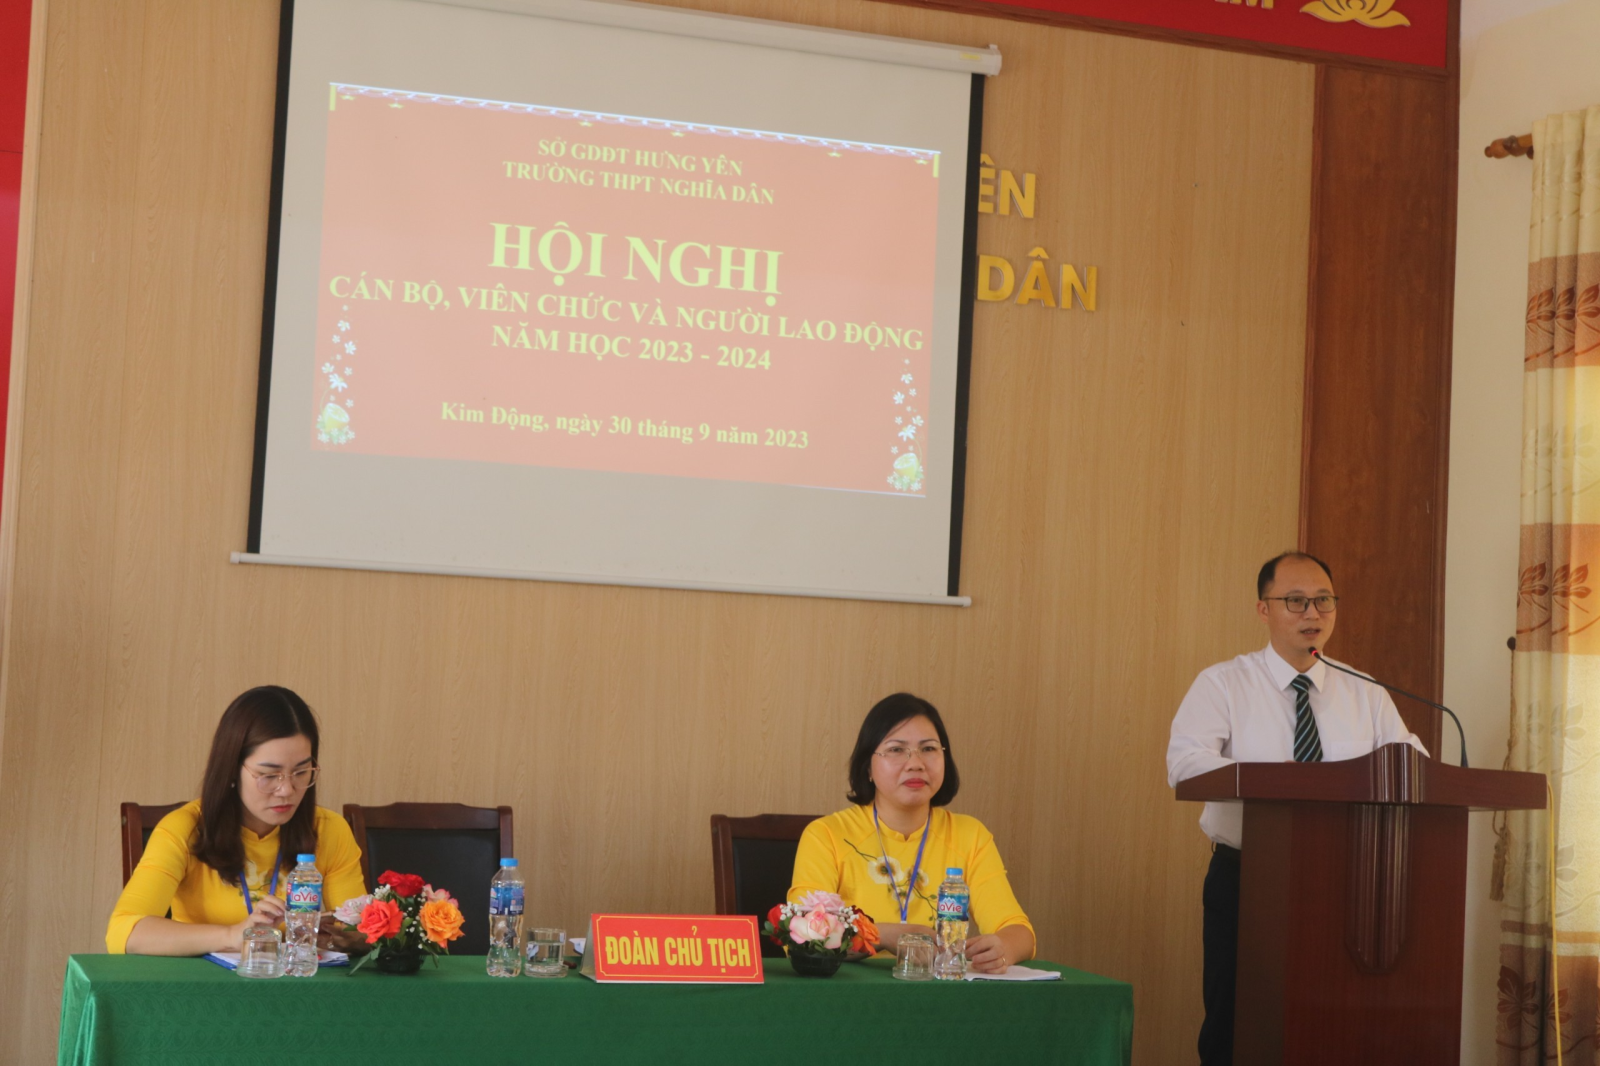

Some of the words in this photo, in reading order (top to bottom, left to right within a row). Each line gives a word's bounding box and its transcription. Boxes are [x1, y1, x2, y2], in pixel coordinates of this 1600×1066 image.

[538, 137, 566, 158] SỞ
[571, 143, 630, 164] GDĐT
[635, 149, 697, 172] HƯNG
[701, 154, 743, 176] YÊN
[502, 161, 595, 186] TRƯỜNG
[600, 171, 655, 193] THPT
[660, 177, 727, 201] NGHĨA
[732, 183, 774, 205] DÂN
[487, 221, 608, 286] HỘI
[622, 235, 784, 307] NGHỊ
[977, 246, 1097, 312] DÂN
[329, 271, 395, 301] CÁN
[402, 280, 451, 311] BỘ,
[458, 283, 530, 313] VIÊN
[537, 292, 622, 322] CHỨC
[629, 298, 668, 327] VÀ
[675, 306, 771, 336] NGƯỜI
[778, 316, 837, 341] LAO
[843, 321, 924, 351] ĐỘNG
[491, 321, 560, 352] NĂM
[567, 331, 632, 361] HỌC
[638, 338, 694, 363] 2023
[716, 345, 772, 370] 2024
[441, 401, 485, 423] Kim
[491, 406, 550, 433] Động,
[556, 413, 604, 437] ngày
[608, 415, 632, 435] 30
[638, 418, 694, 445] tháng
[699, 422, 711, 441] 9
[716, 426, 759, 445] năm
[764, 428, 809, 449] 2023
[605, 930, 660, 966] ĐOÀN
[664, 925, 703, 966] CHỦ
[707, 938, 751, 973] TỊCH
